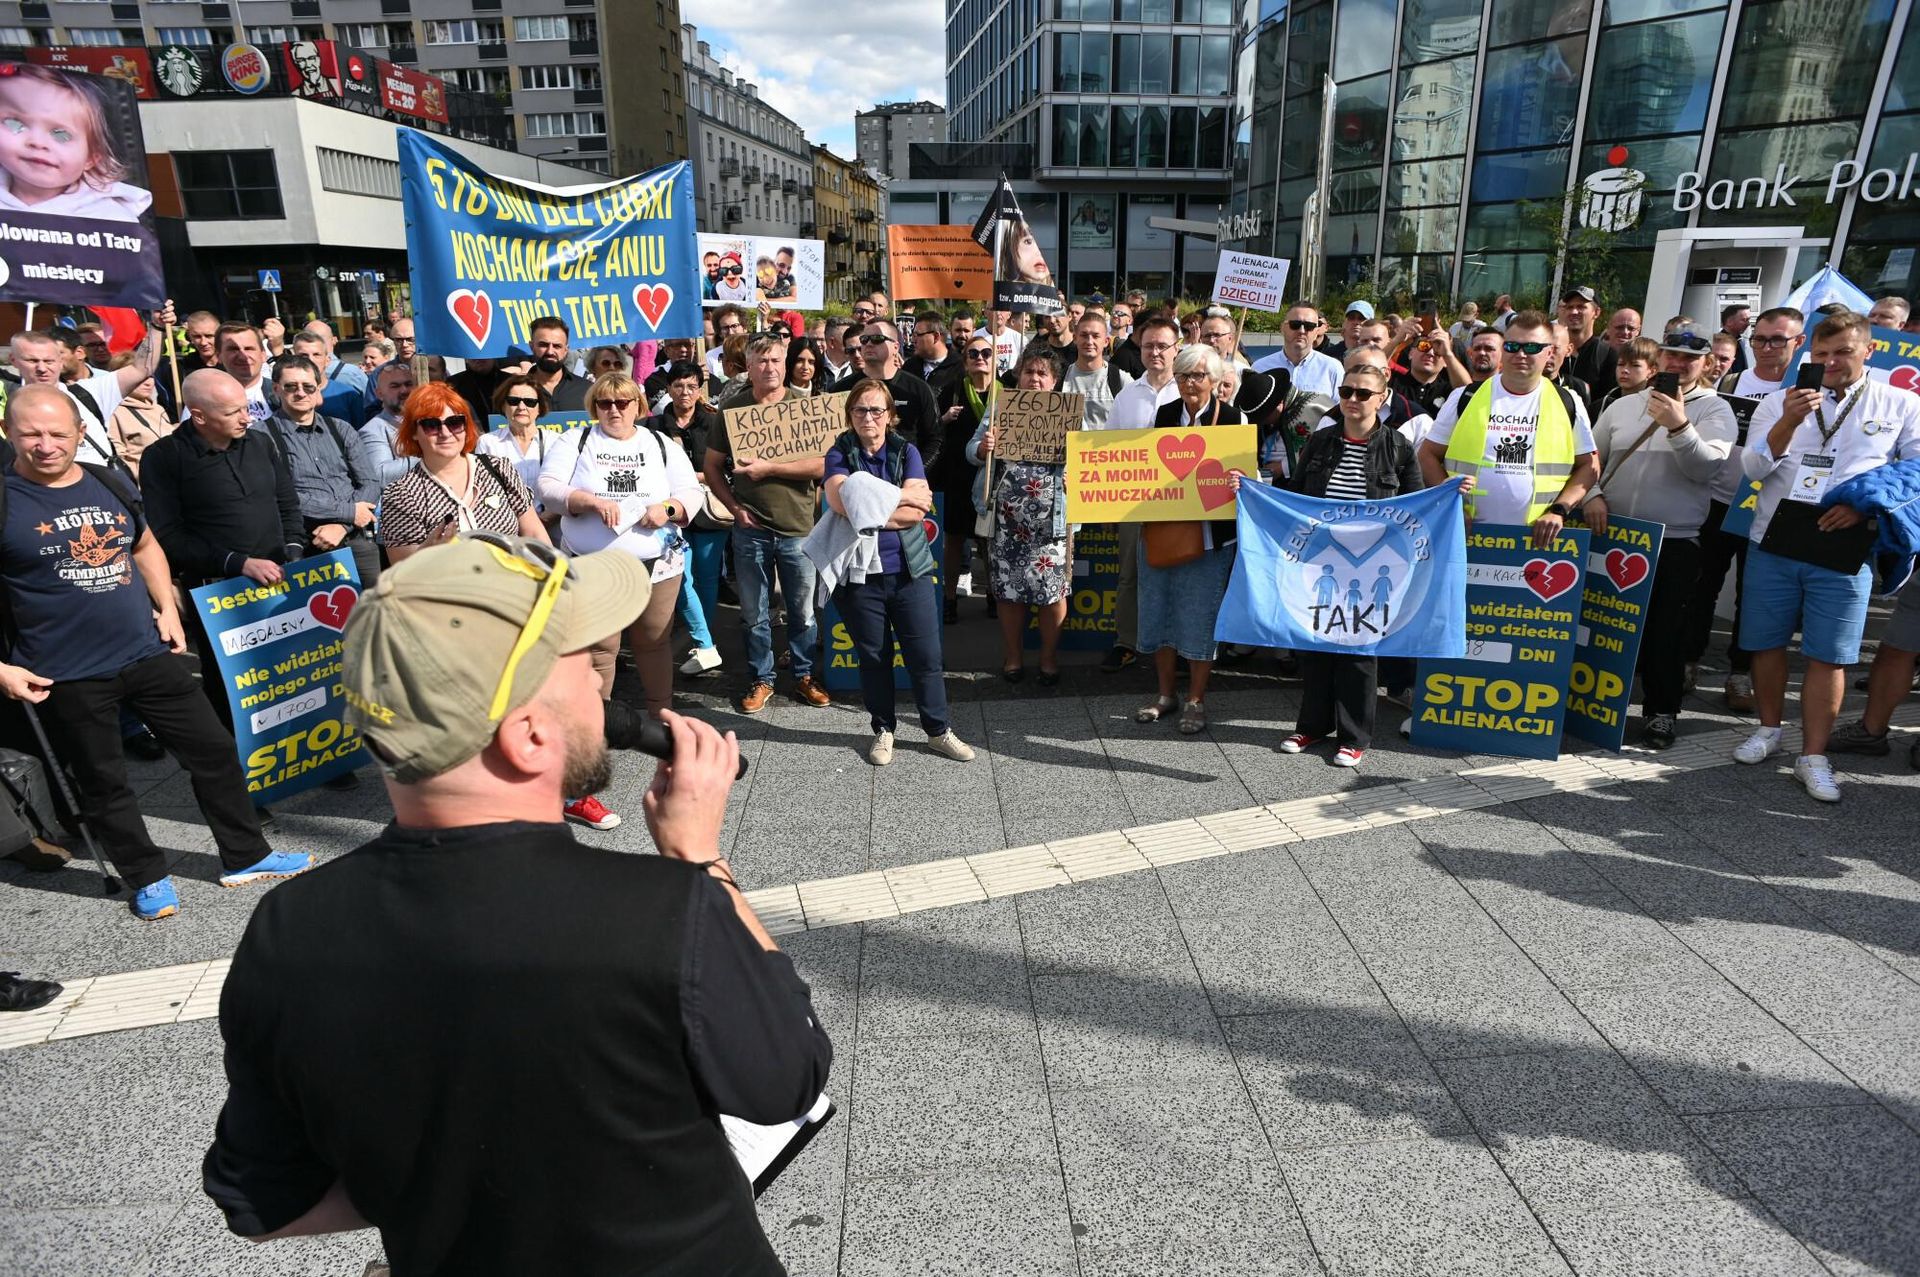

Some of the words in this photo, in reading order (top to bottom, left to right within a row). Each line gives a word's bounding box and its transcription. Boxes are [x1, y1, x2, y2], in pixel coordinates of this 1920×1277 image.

[227, 52, 258, 70] BURGER
[231, 64, 261, 81] KING
[386, 77, 416, 96] MEGABOX
[388, 90, 394, 105] 5
[1672, 163, 1801, 212] Bank
[483, 177, 538, 225] DNI
[1233, 209, 1262, 240] Polski
[76, 232, 101, 247] od
[103, 232, 141, 252] Taty
[450, 229, 549, 282] KOCHAM
[556, 240, 602, 286] CIĘ
[605, 235, 666, 278] ANIU
[1231, 256, 1279, 270] ALIENACJA
[22, 263, 104, 284] miesięcy
[339, 272, 385, 282] STAKS
[1225, 276, 1267, 288] CIERPIENIE
[1240, 269, 1269, 278] DRAMAT
[1013, 294, 1037, 304] DOBRO
[1220, 286, 1261, 302] DZIECI
[1264, 294, 1276, 305] !!!
[564, 293, 628, 339] TATA
[1004, 390, 1043, 412] 766
[1047, 392, 1078, 413] DNI
[735, 396, 835, 431] KACPEREK
[1000, 412, 1027, 428] BEZ
[1028, 415, 1082, 431] KONTAKTU
[734, 425, 782, 451] ZOSIA
[790, 413, 847, 439] NATALI
[999, 428, 1008, 440] Z
[1014, 429, 1066, 444] WNUKAM
[1503, 424, 1533, 432] alienuj
[756, 434, 825, 461] KOCHAMY
[997, 443, 1025, 456] STOP
[1079, 448, 1149, 466] TĘSKNIĘ
[1166, 450, 1196, 460] LAURA
[1079, 470, 1100, 483] ZA
[1106, 468, 1159, 483] MOIMI
[1079, 487, 1185, 503] WNUCZKAMI
[54, 511, 115, 531] HOUSE
[1364, 504, 1422, 536] DRUK
[1466, 534, 1515, 549] stem
[1523, 536, 1579, 557] TTĄ
[1607, 525, 1652, 552] TATĄ
[40, 545, 66, 555] EST.
[1080, 545, 1119, 555] dzieck
[206, 579, 290, 614] Jestem
[1582, 588, 1640, 616] działem
[1308, 603, 1389, 636] TAK!
[1470, 601, 1573, 623] widziałem
[1582, 609, 1637, 634] dziecka
[225, 617, 305, 652] MAGDALENY
[1501, 622, 1570, 641] dziecka
[1594, 634, 1624, 653] DNI
[1519, 647, 1555, 663] DNI
[235, 668, 270, 689] Nie
[241, 675, 307, 709] mojego
[310, 662, 344, 682] dzie
[1424, 673, 1559, 714] STOP
[1420, 707, 1554, 735] ALIENACJI
[248, 736, 366, 793] ALIENACJ
